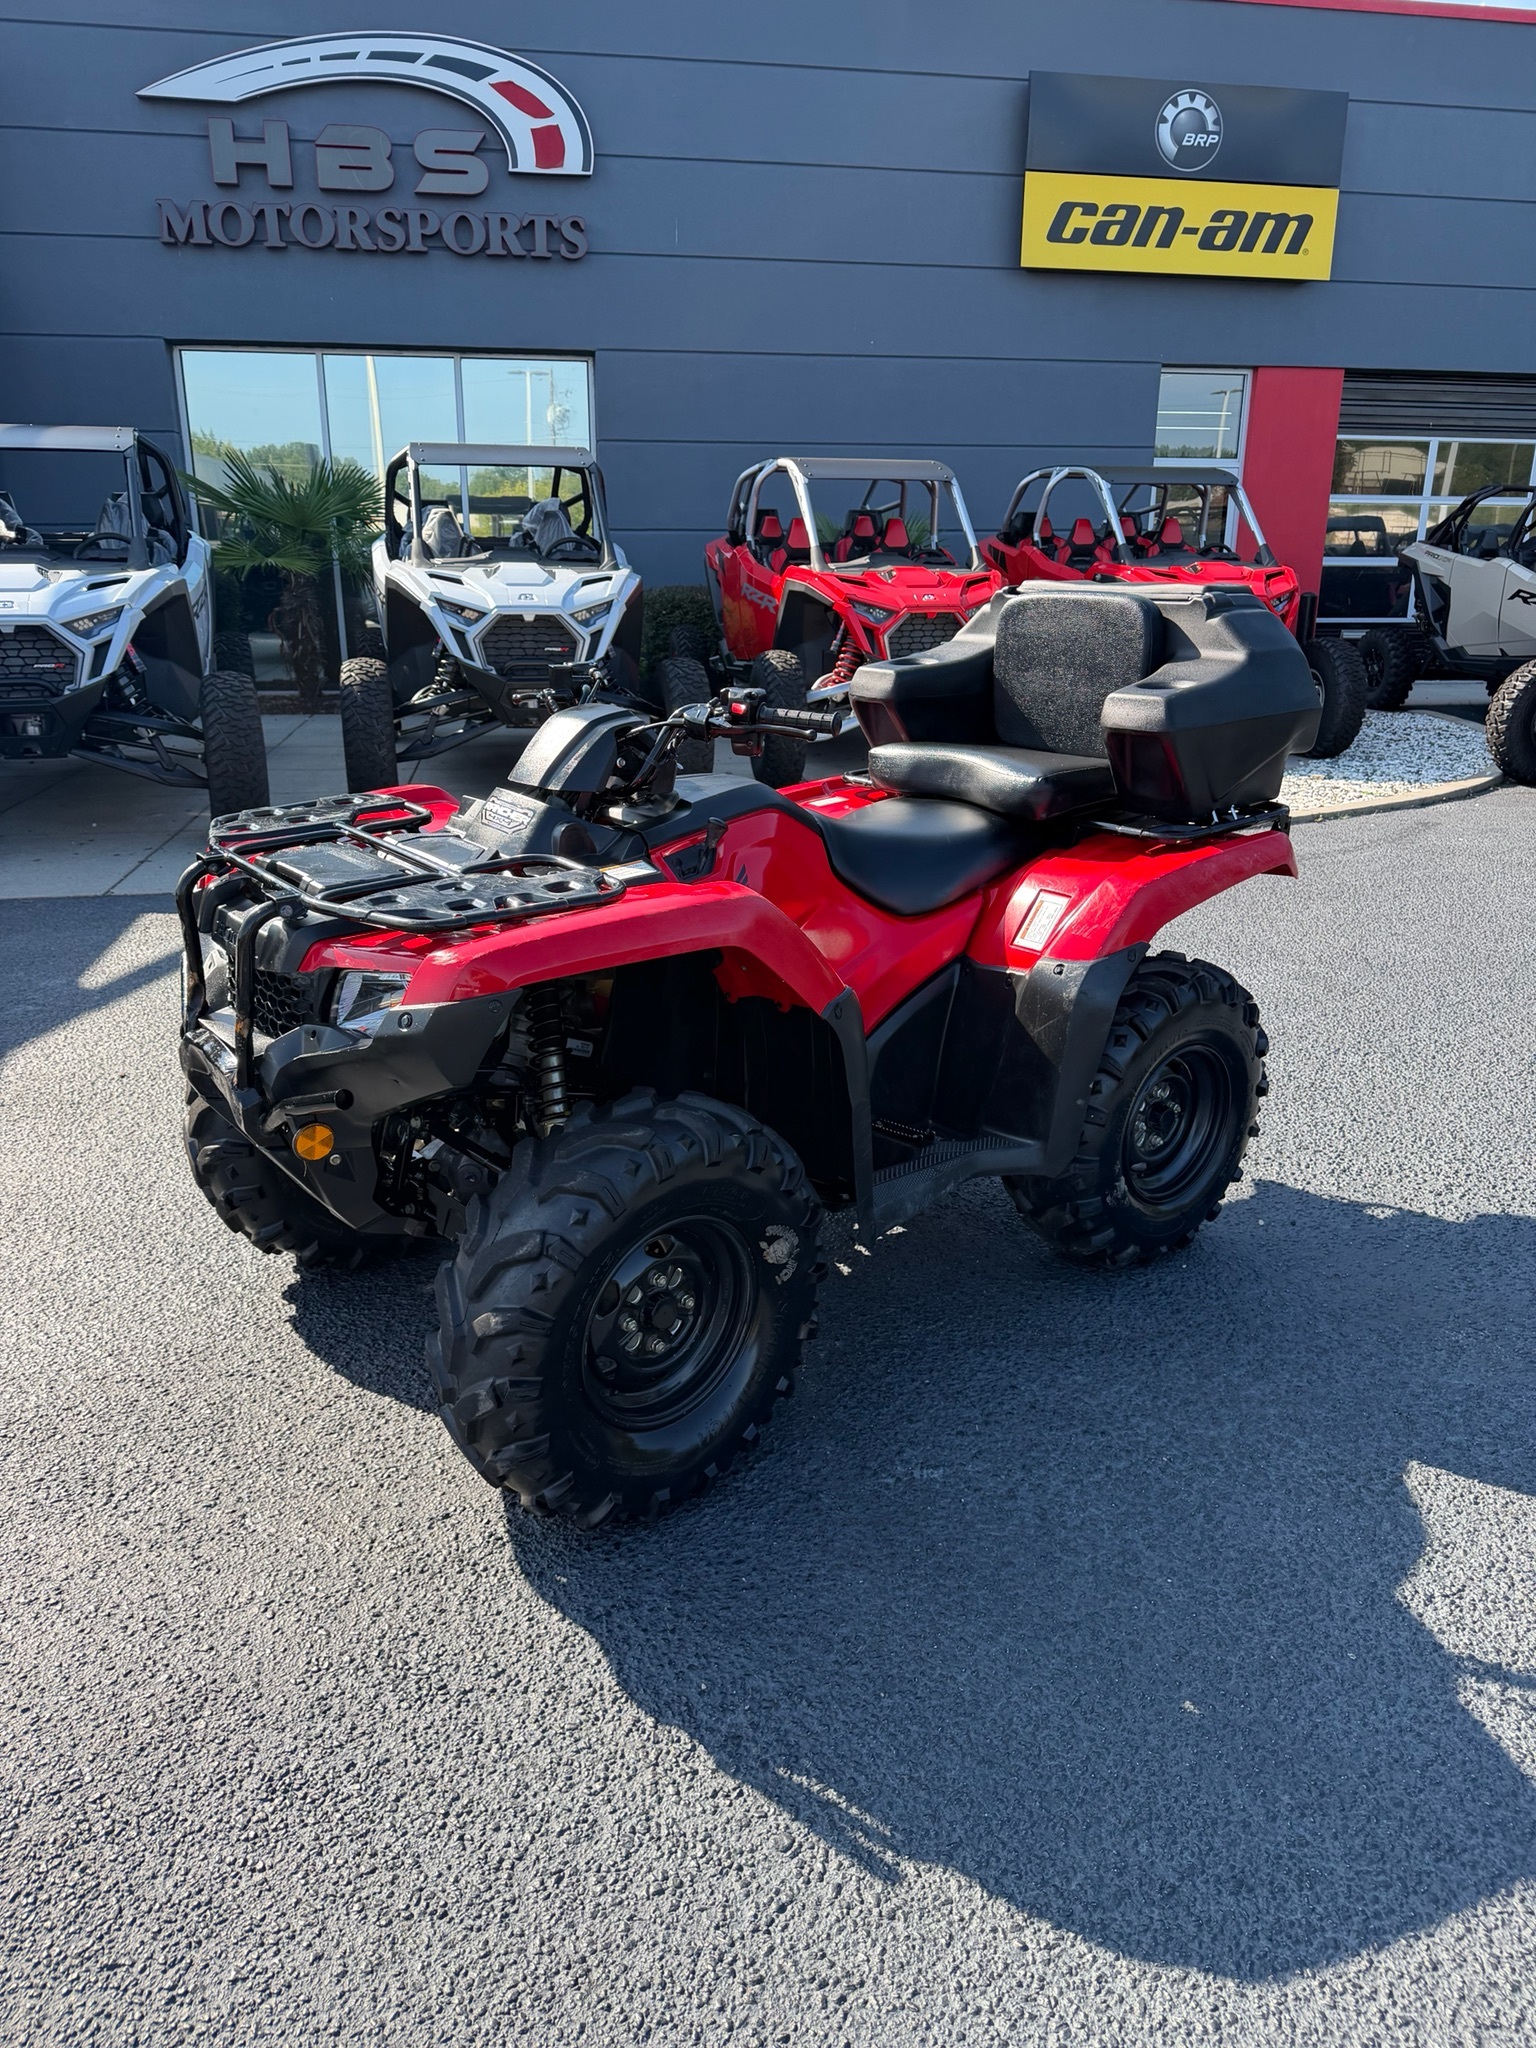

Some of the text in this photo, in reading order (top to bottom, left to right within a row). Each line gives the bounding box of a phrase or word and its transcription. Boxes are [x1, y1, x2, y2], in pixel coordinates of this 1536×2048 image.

[207, 116, 490, 195] HBS
[1182, 133, 1218, 147] BRP
[156, 198, 589, 260] MOTORSPORTS
[1046, 201, 1314, 255] can-am
[741, 581, 778, 615] RZR
